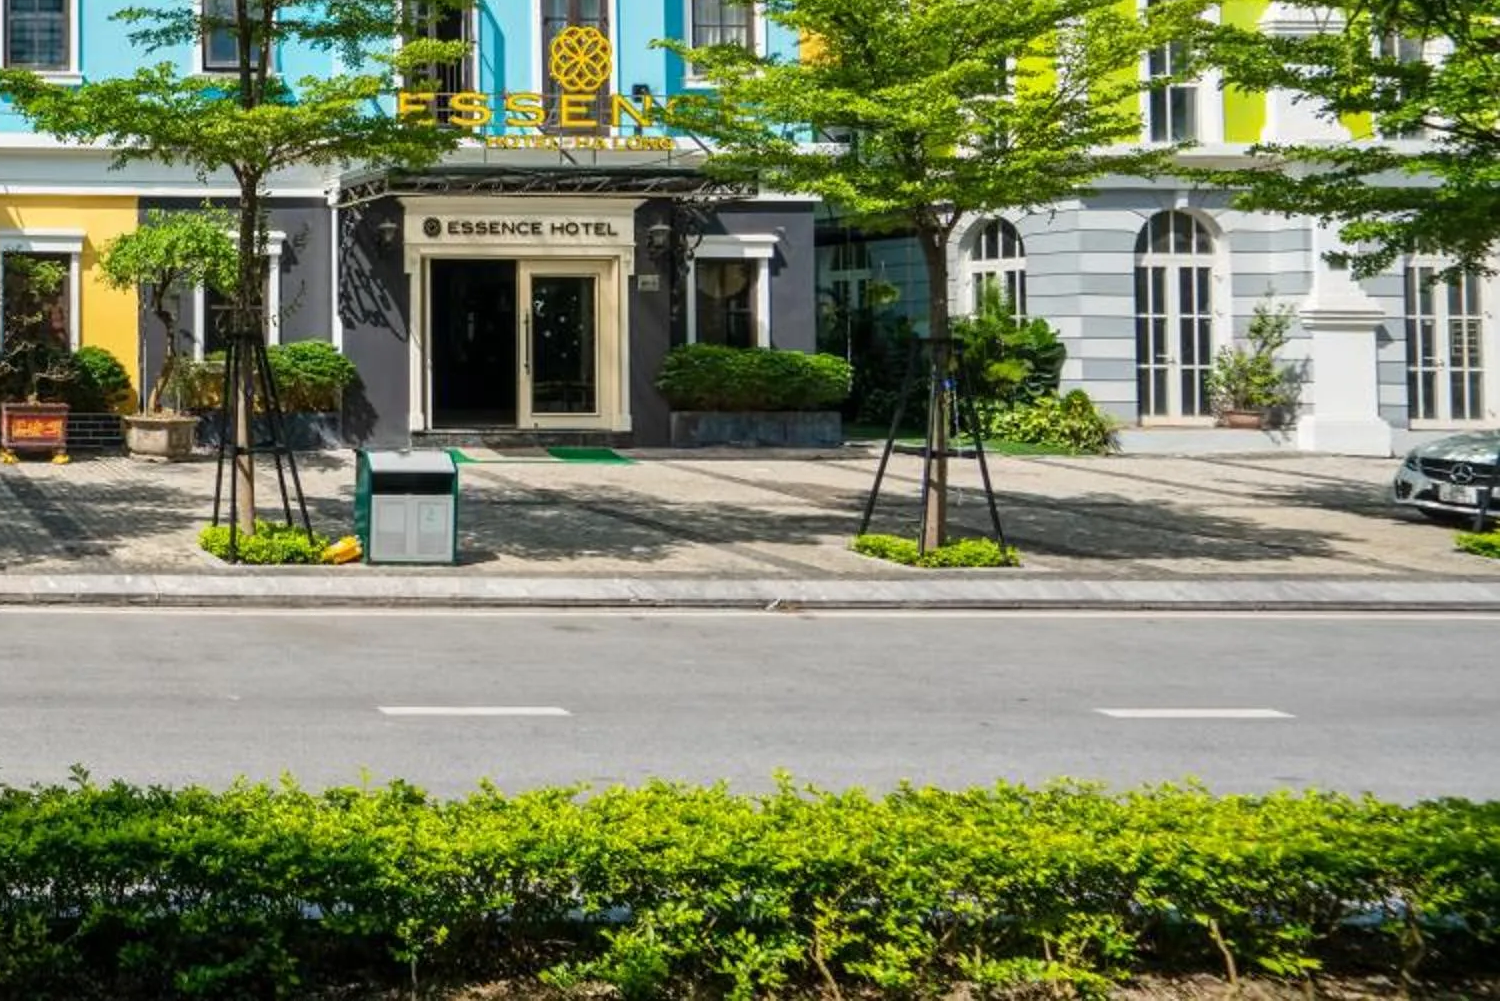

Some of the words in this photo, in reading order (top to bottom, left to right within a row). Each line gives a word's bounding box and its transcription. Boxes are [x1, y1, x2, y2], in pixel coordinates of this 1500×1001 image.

[397, 90, 713, 129] ESSEN
[447, 220, 543, 236] ESSENCE
[550, 220, 619, 236] HOTEL
